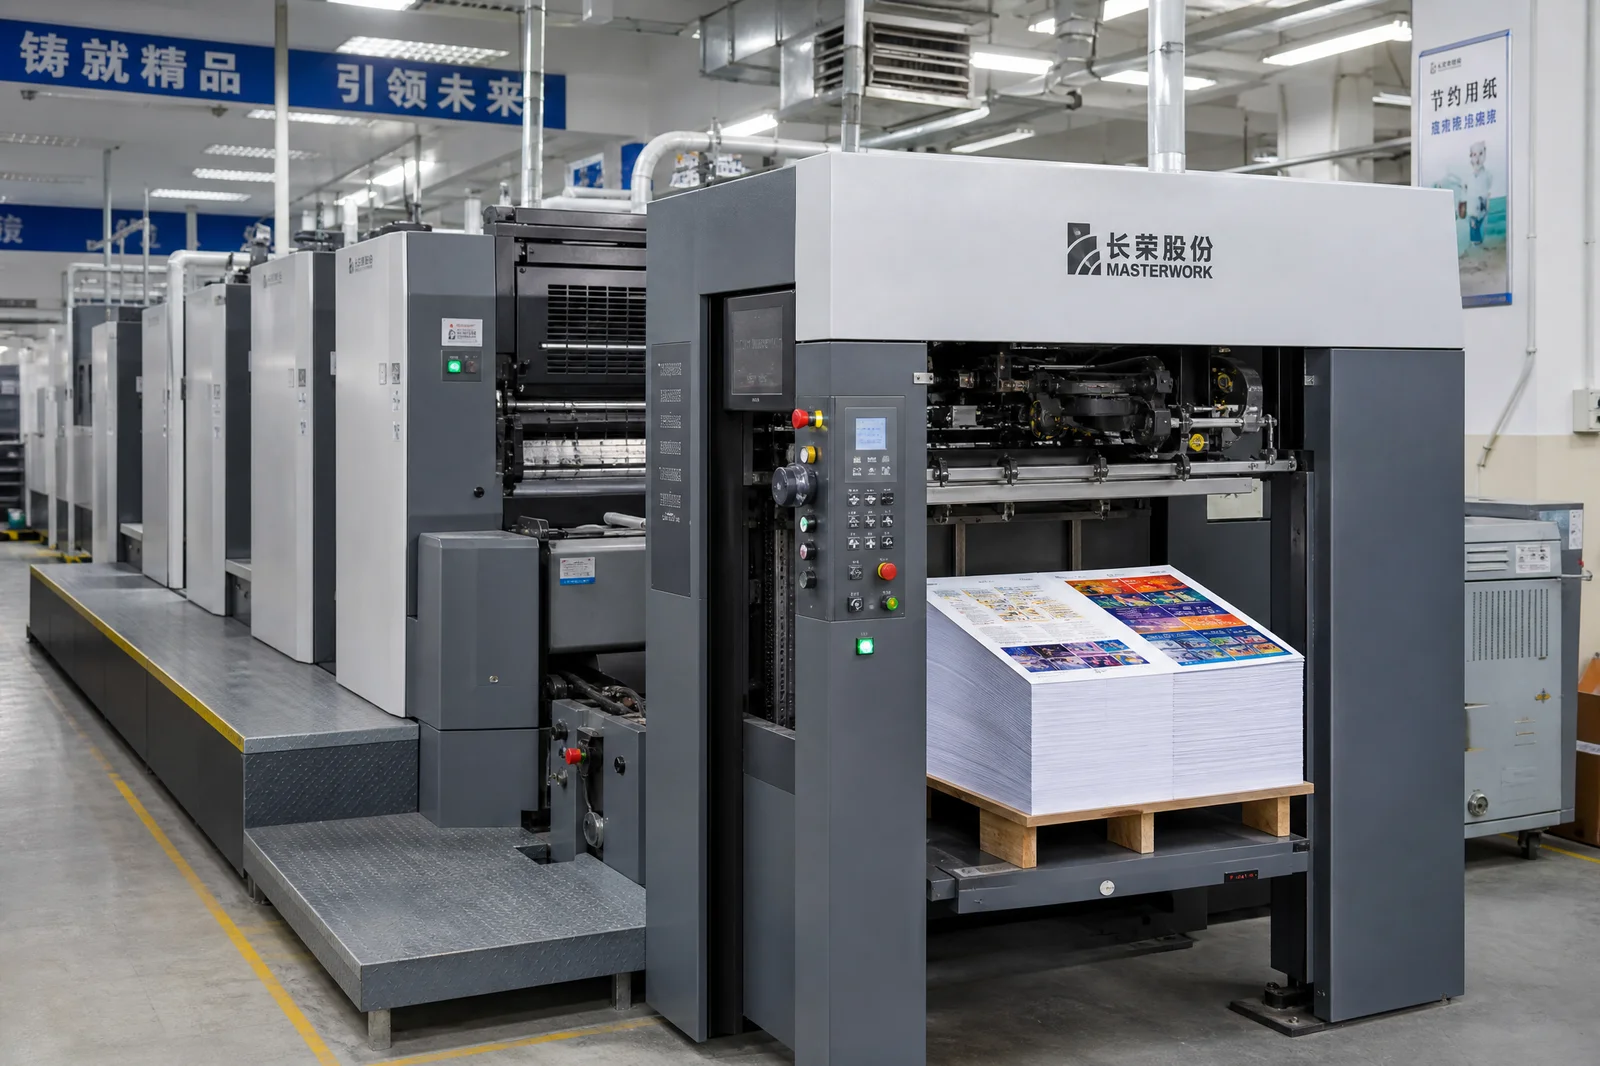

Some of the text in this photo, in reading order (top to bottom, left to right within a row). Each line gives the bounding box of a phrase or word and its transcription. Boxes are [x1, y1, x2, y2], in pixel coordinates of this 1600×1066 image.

[19, 30, 241, 95] 铸就精品
[336, 63, 524, 117] 引领未来
[1430, 77, 1498, 112] 节约用纸
[1106, 232, 1214, 263] 长荣股份
[1106, 263, 1213, 279] MASTERWORK
